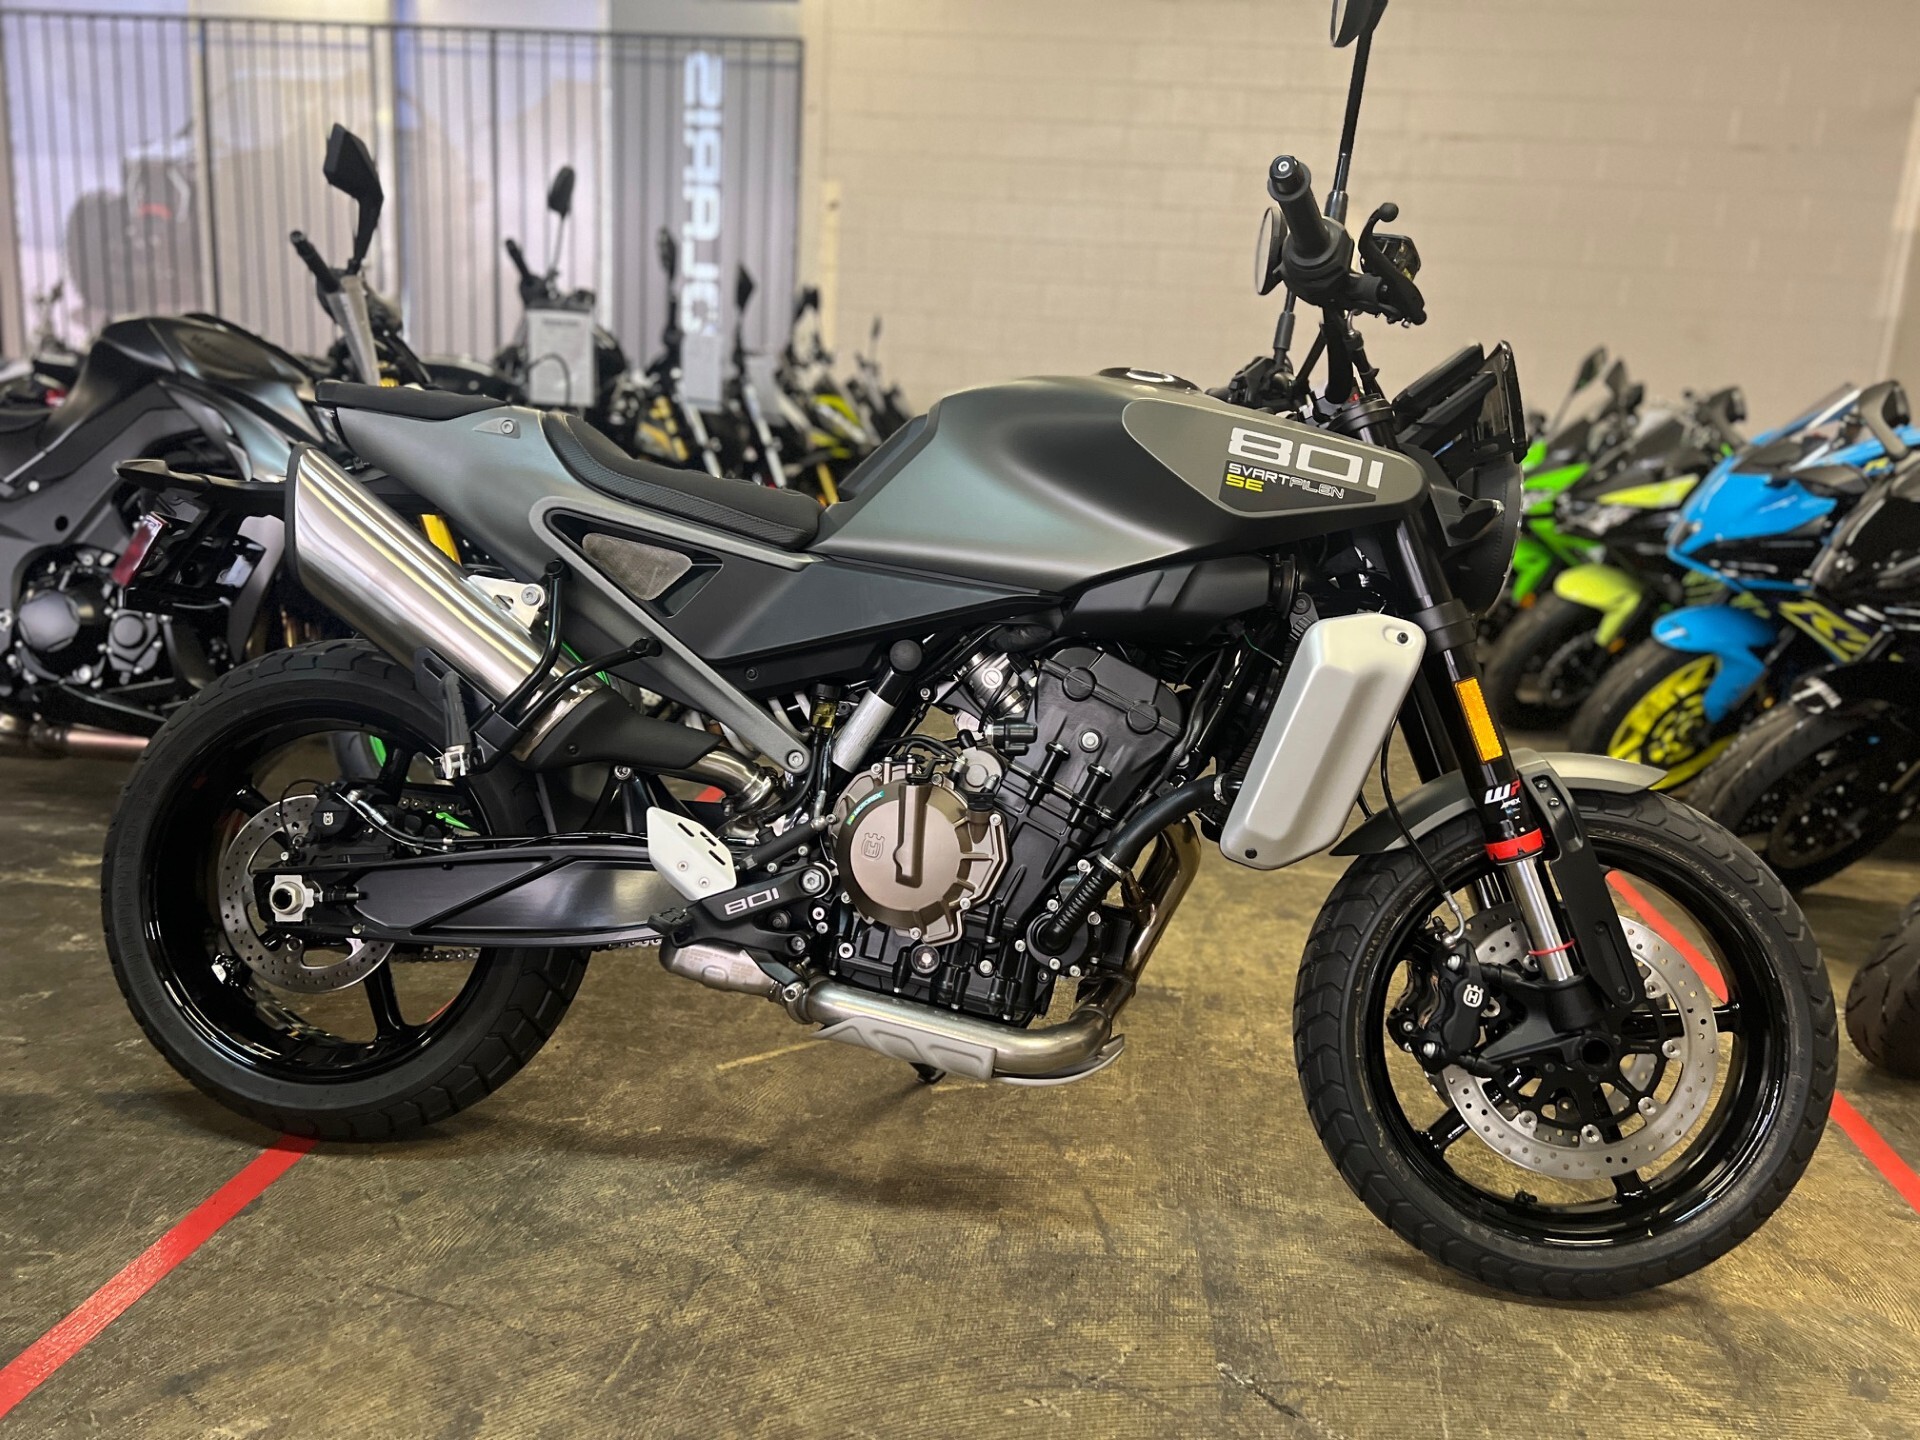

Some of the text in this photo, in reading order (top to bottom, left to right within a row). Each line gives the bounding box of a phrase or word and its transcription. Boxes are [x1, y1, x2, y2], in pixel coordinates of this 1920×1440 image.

[1228, 427, 1384, 489] 801
[1225, 474, 1264, 492] SE
[1228, 462, 1344, 499] SVARTPILEN
[724, 887, 780, 915] 801
